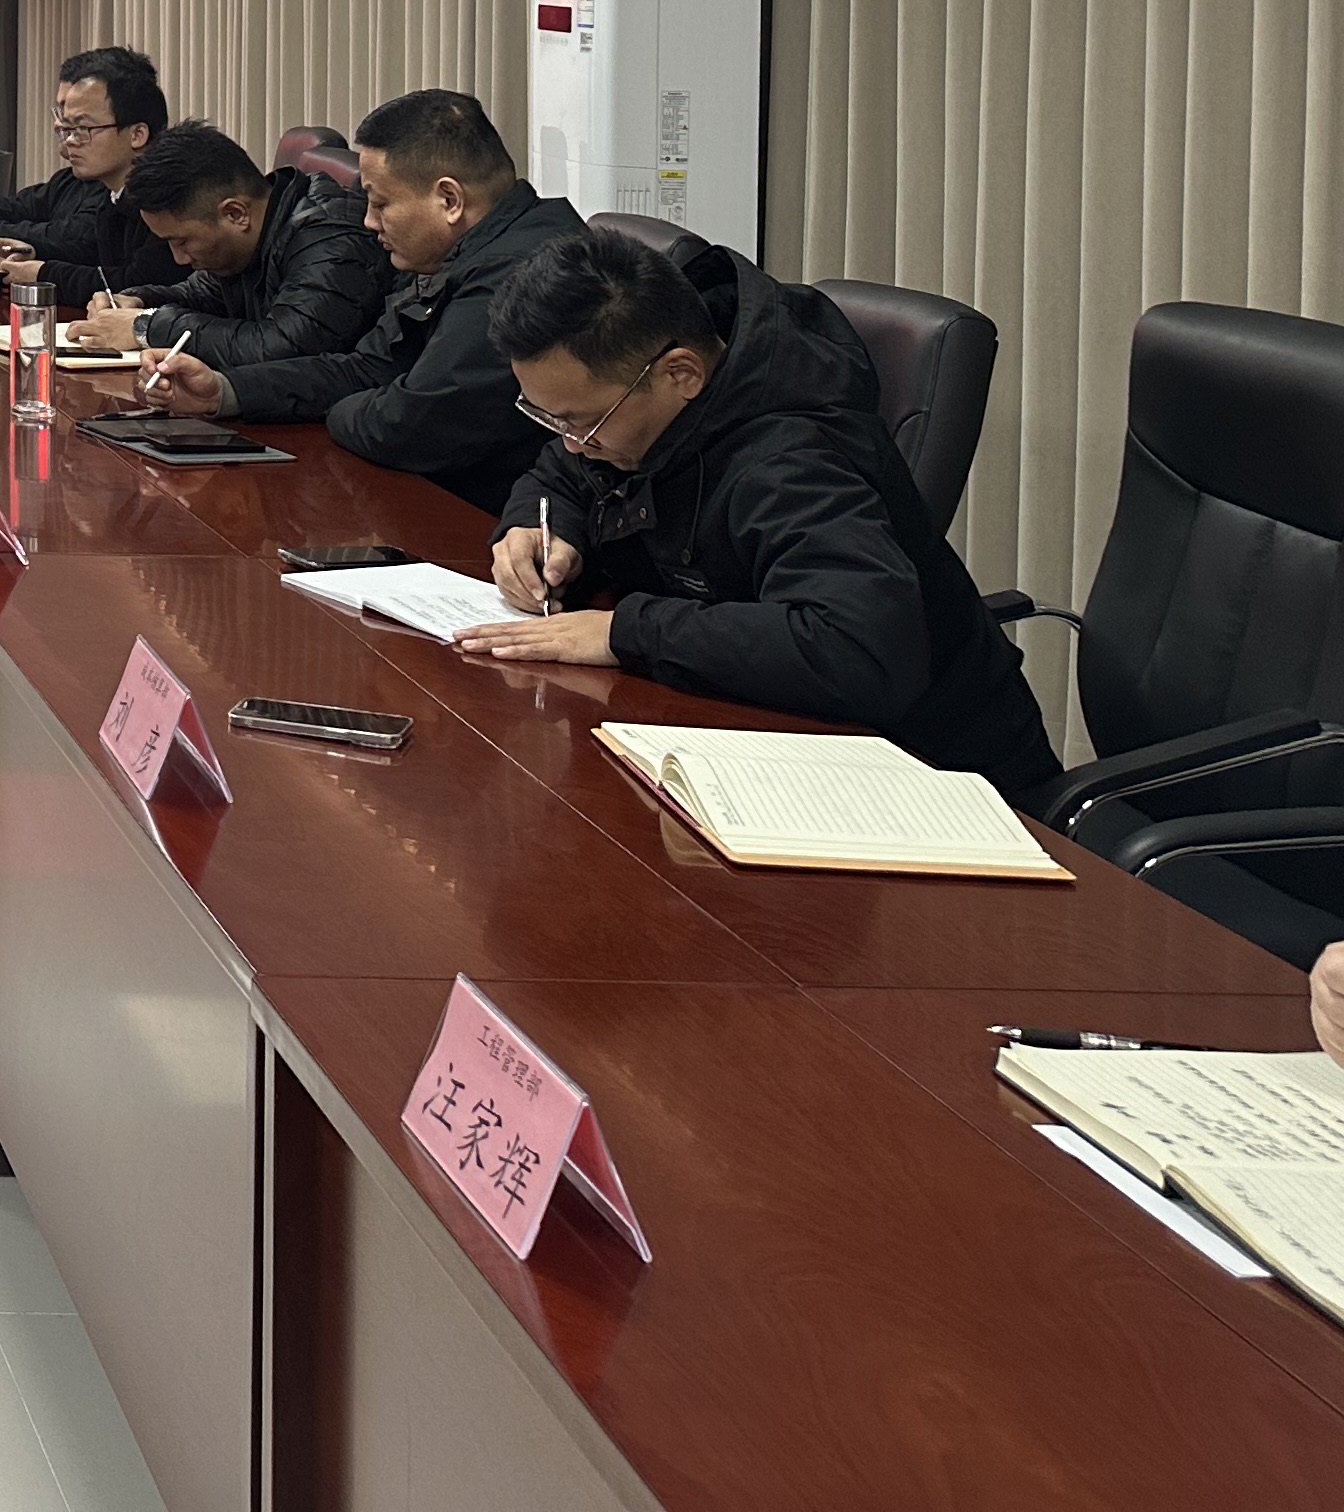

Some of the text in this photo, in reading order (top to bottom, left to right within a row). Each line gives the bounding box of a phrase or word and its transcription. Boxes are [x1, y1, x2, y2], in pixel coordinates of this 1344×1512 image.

[476, 1025, 543, 1103] 工程管理部
[421, 1062, 541, 1219] 汪家辉
